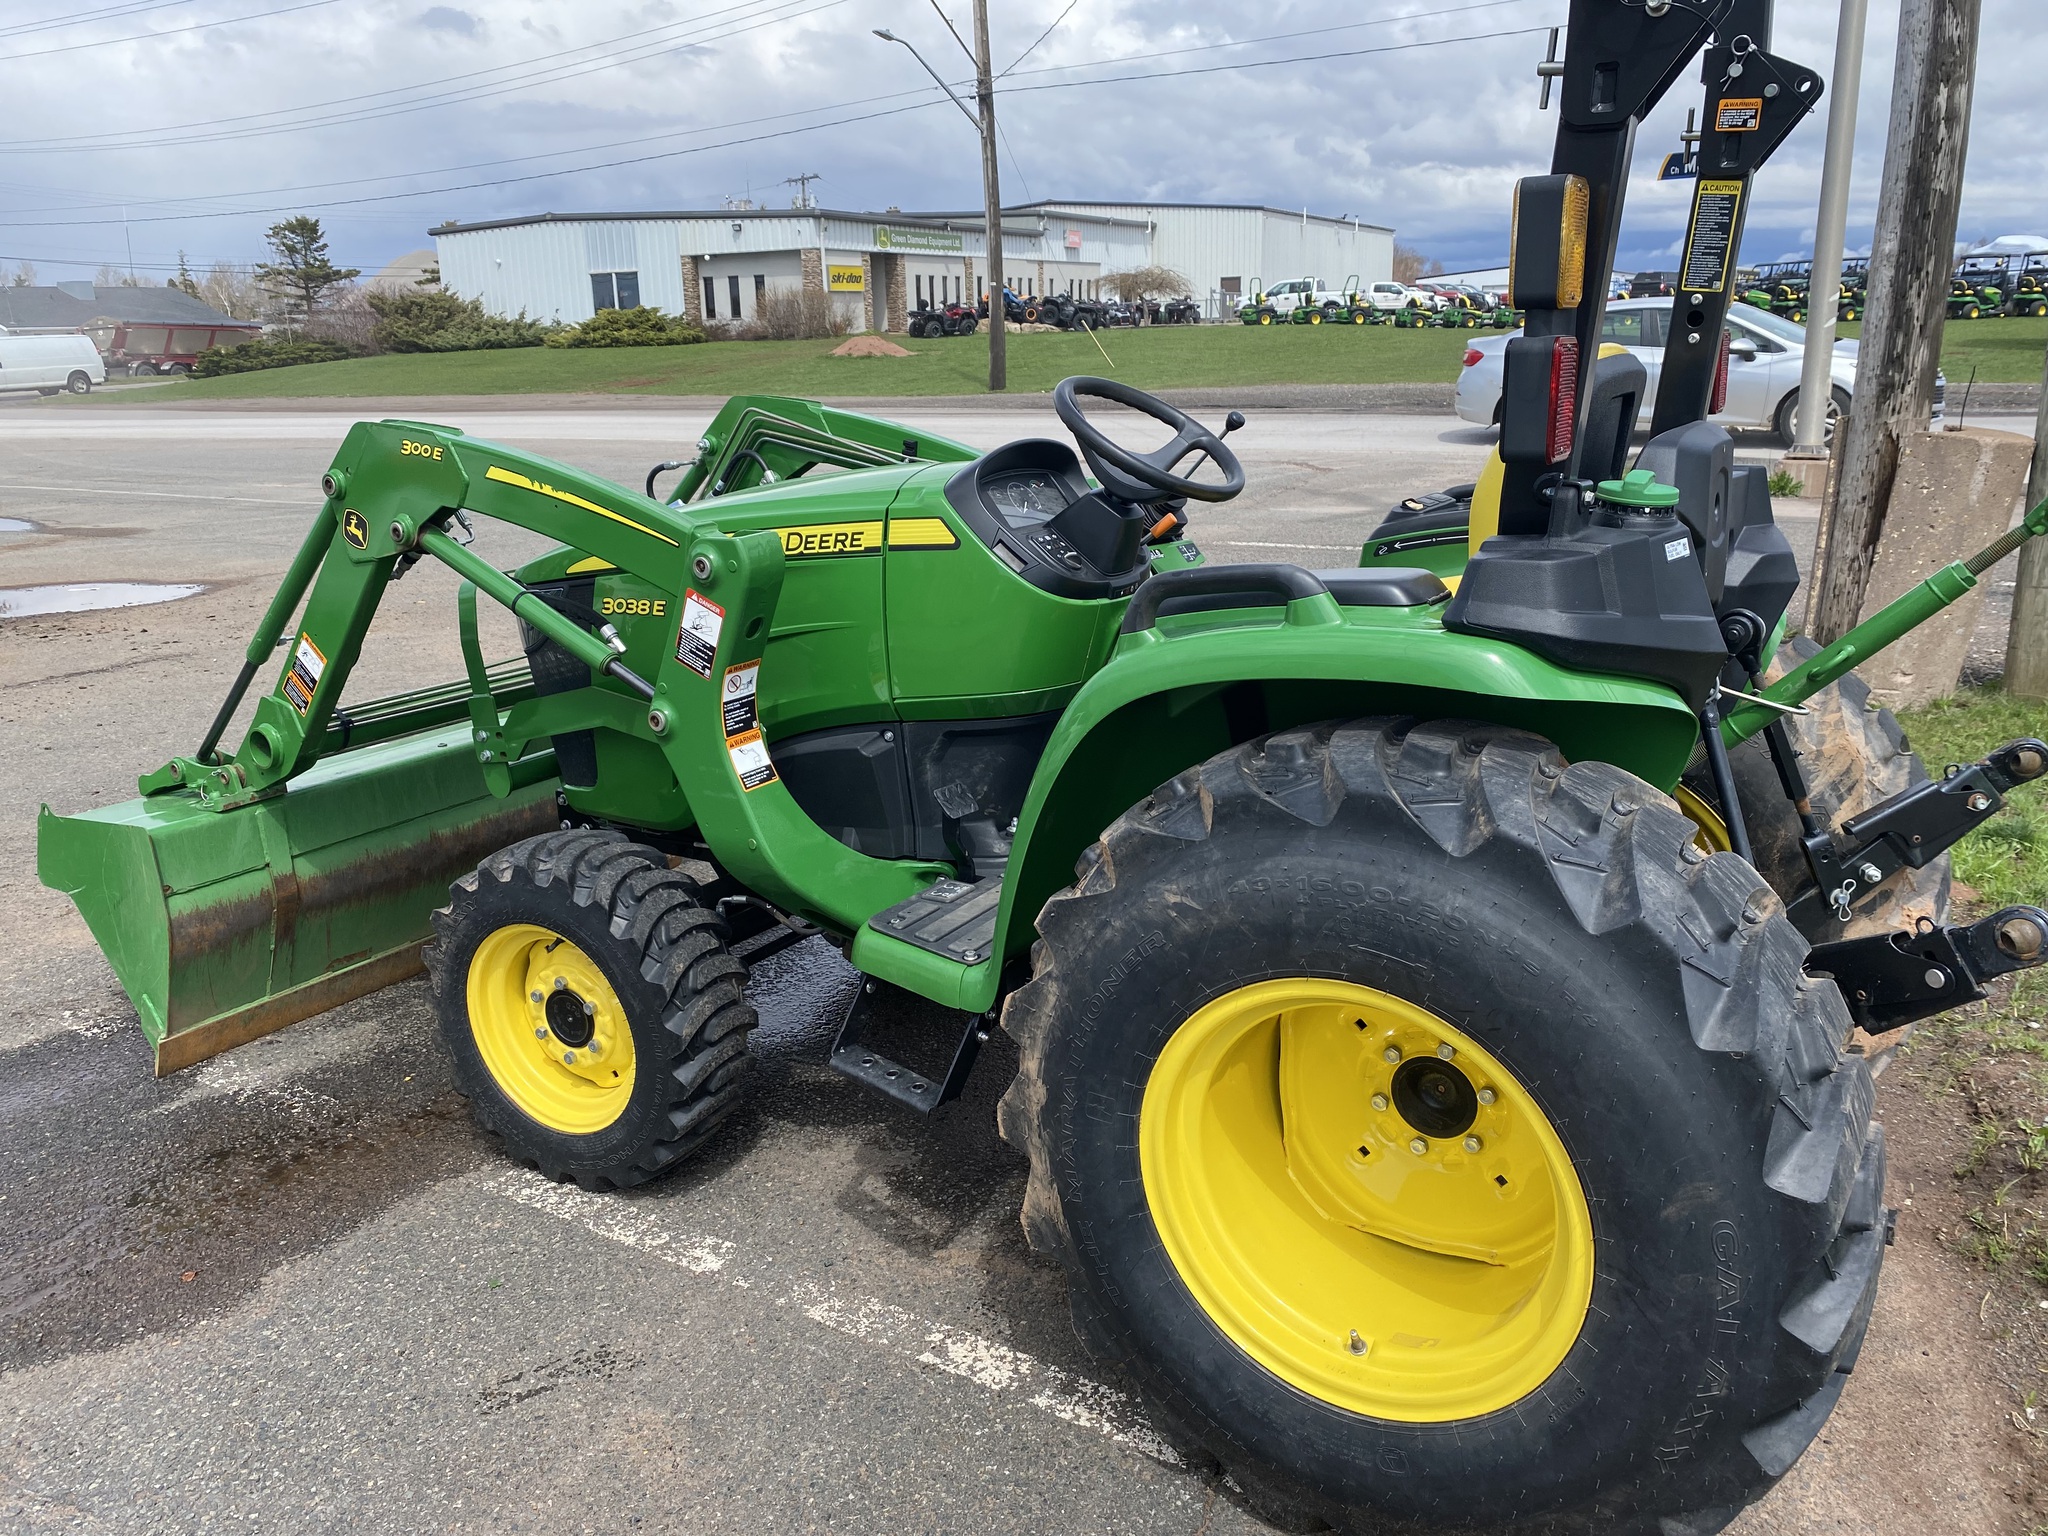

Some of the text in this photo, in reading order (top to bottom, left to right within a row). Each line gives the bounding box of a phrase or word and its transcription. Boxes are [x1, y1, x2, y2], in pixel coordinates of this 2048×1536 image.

[1670, 166, 1680, 175] Ch
[1709, 184, 1740, 192] CAUTION
[891, 233, 907, 243] Green
[907, 234, 928, 245] Diamond
[928, 236, 952, 248] Equipment
[831, 272, 862, 283] ski-doo
[785, 531, 865, 554] DEERE
[698, 597, 721, 614] DANGER
[733, 660, 760, 672] WARNING
[733, 731, 761, 746] WARNING
